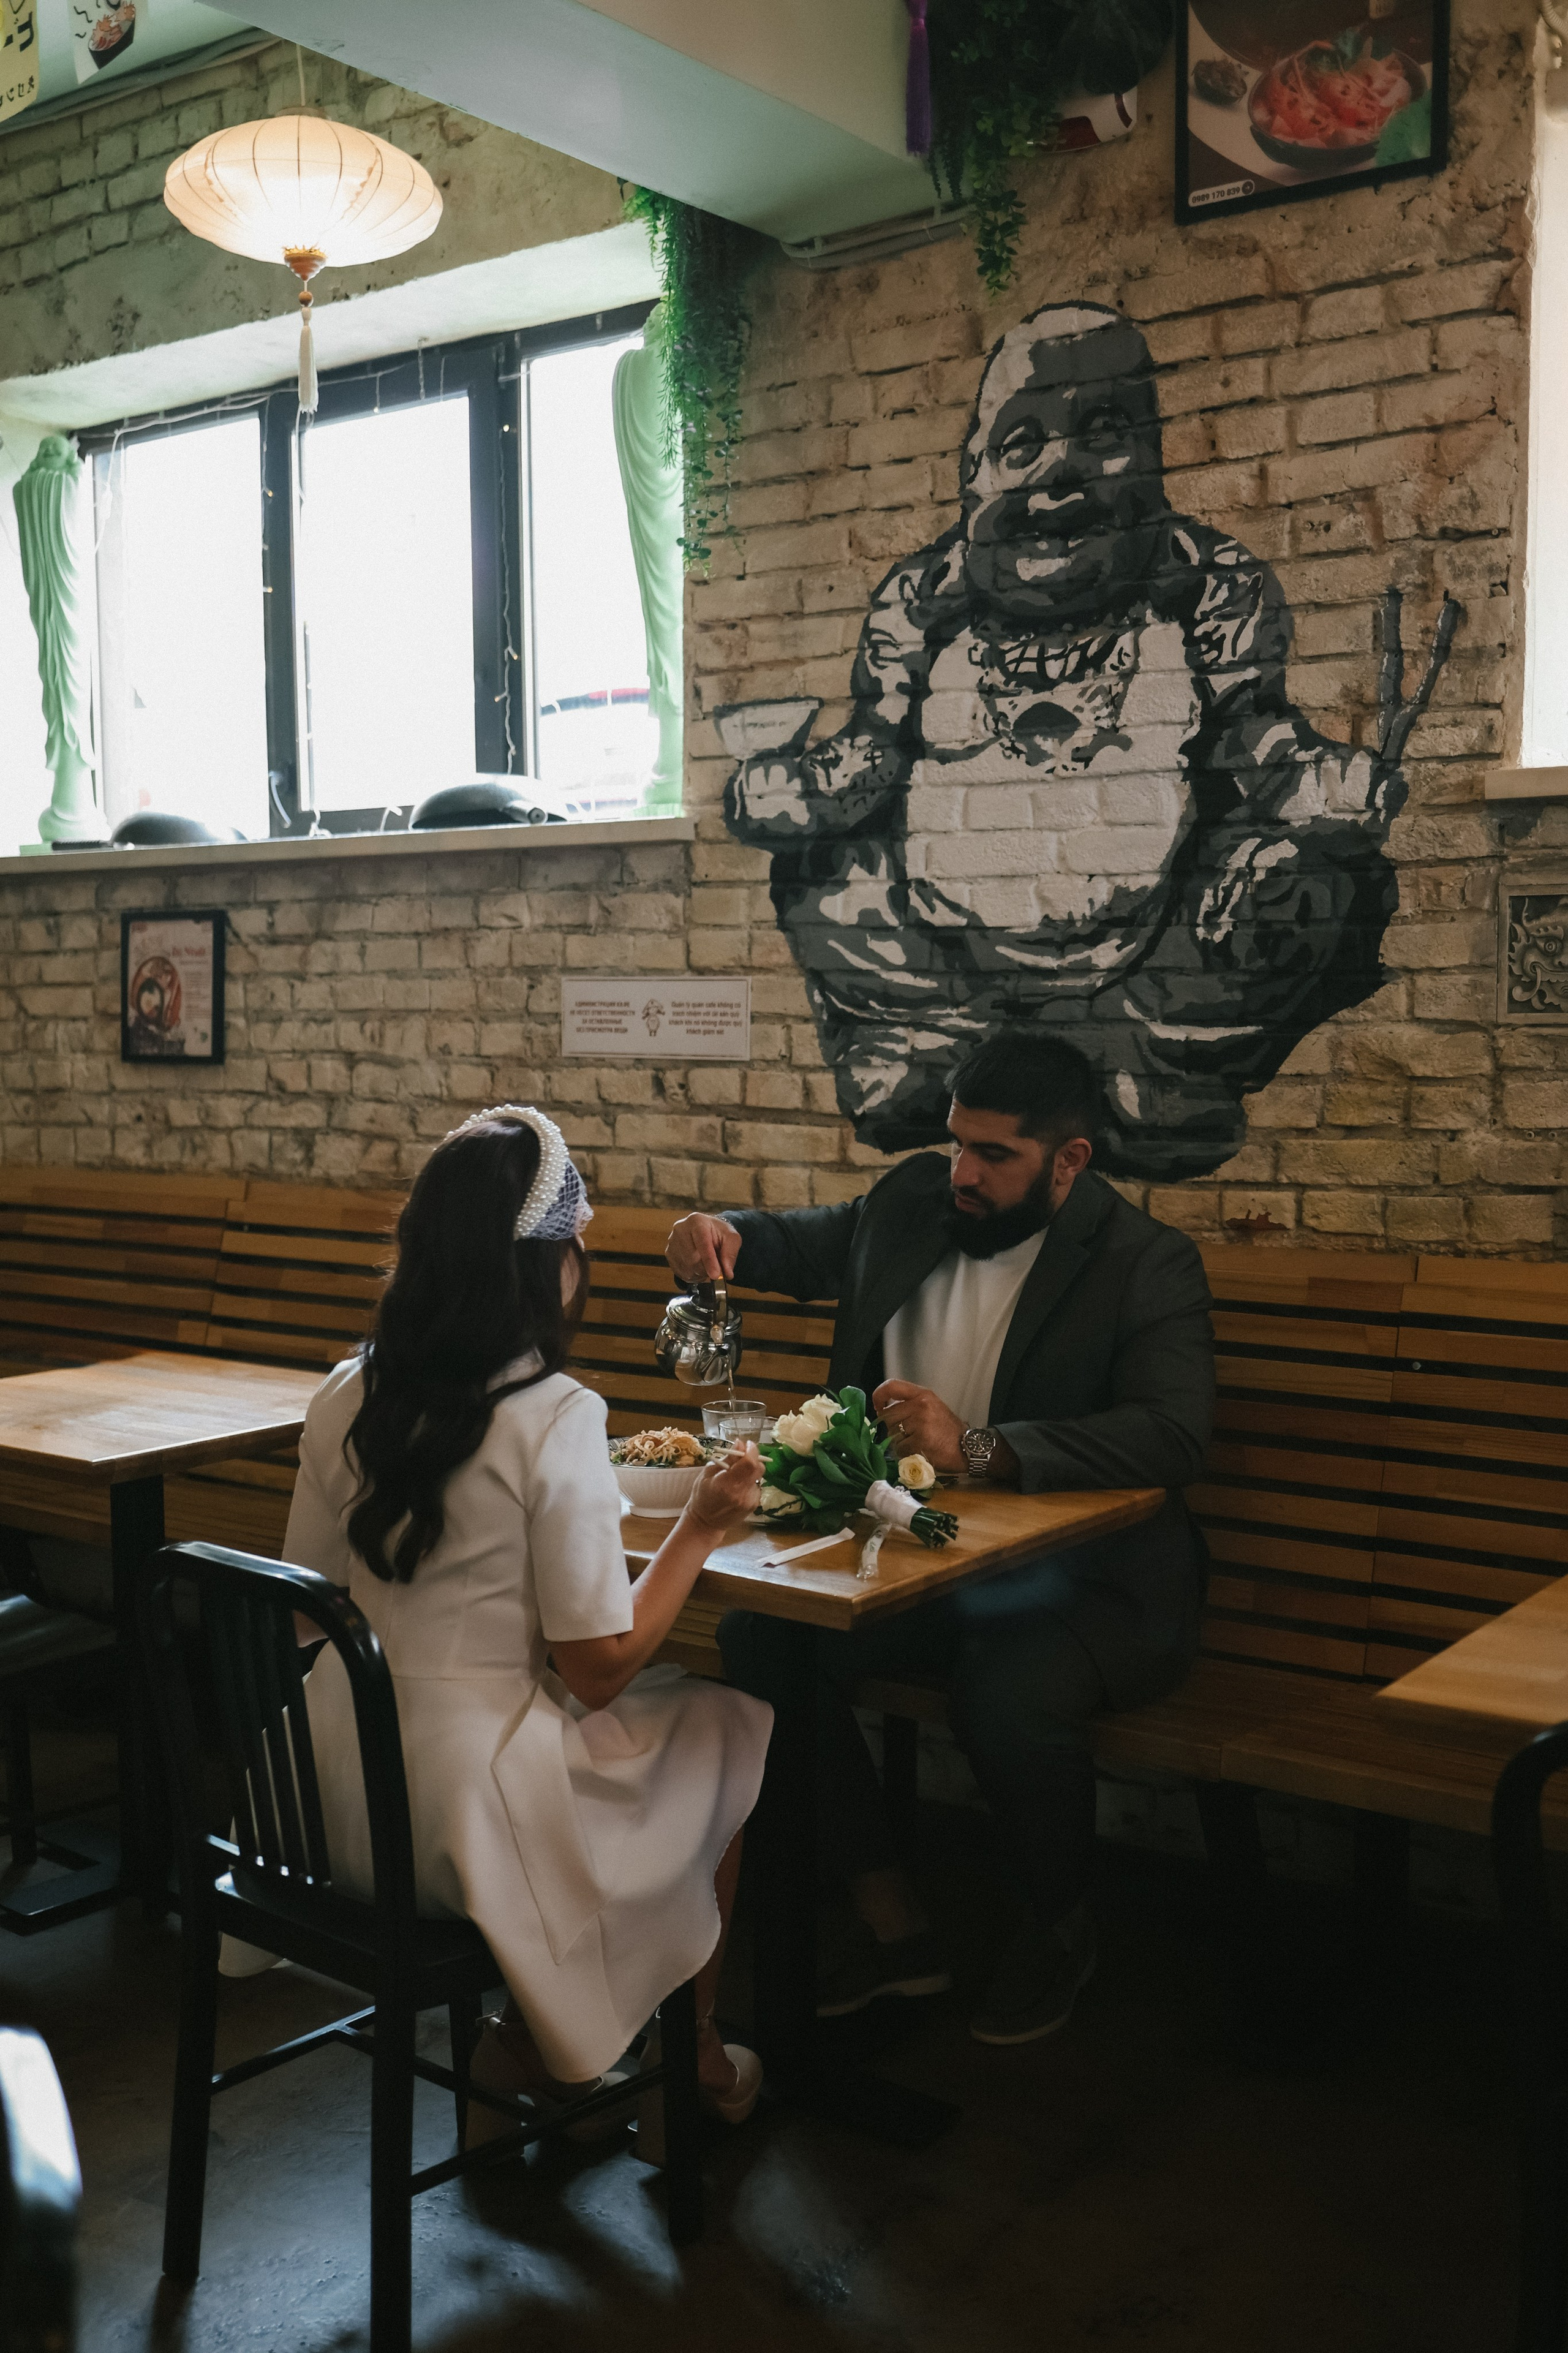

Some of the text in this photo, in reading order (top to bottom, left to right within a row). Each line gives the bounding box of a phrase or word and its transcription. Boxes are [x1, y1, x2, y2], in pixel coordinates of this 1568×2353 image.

[1192, 186, 1240, 203] 0989 170 839
